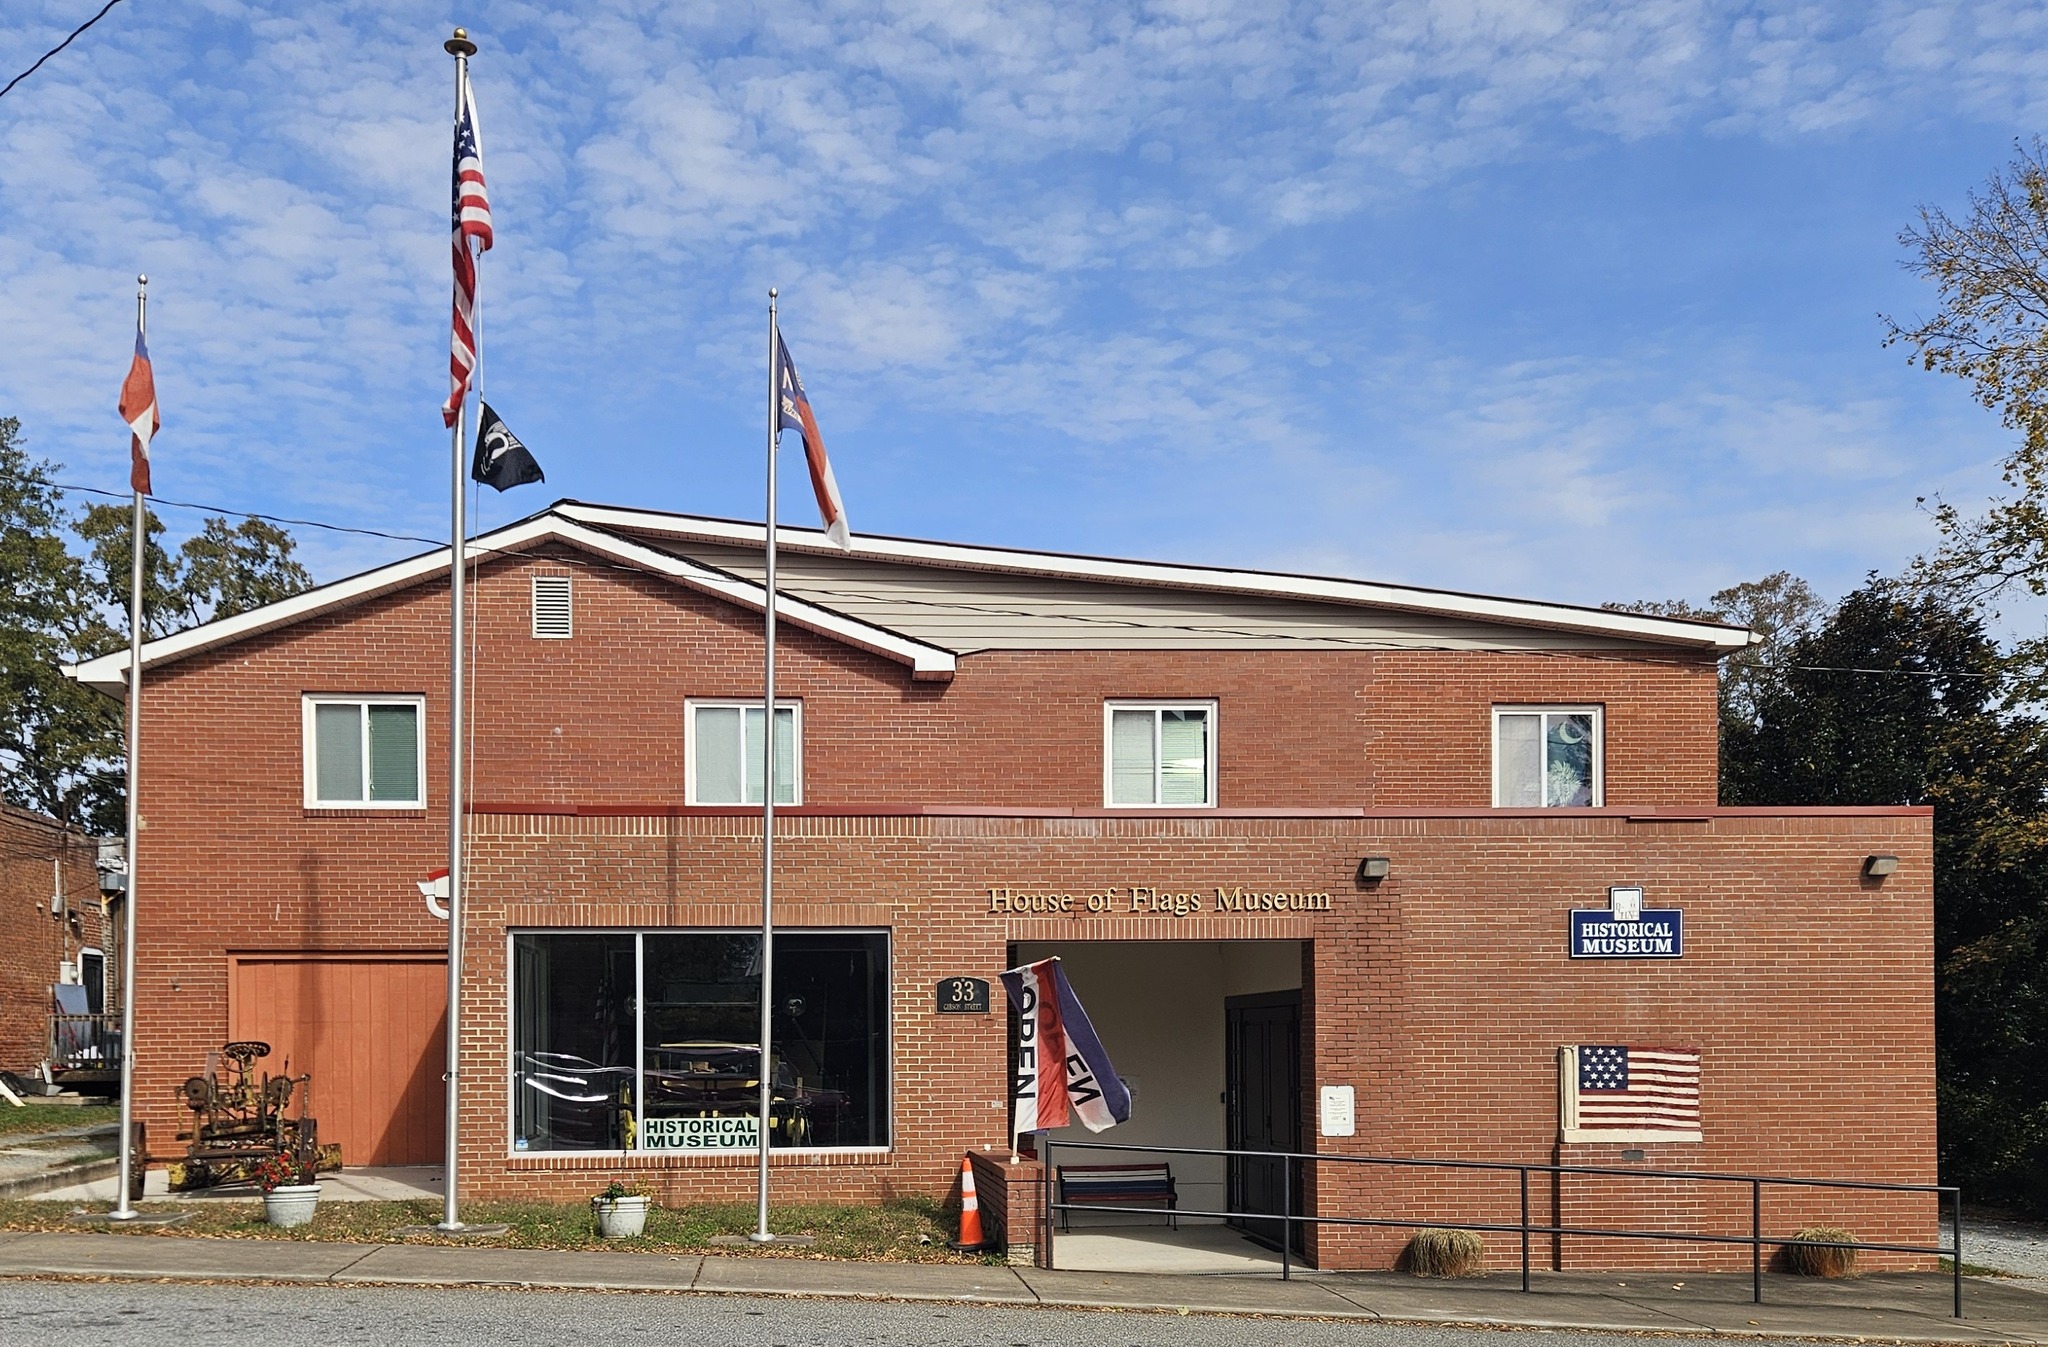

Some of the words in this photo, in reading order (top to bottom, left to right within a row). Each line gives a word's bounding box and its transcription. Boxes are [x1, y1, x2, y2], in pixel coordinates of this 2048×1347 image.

[988, 887, 1074, 913] House
[1086, 886, 1117, 913] of
[1129, 887, 1202, 917] Flags
[1214, 886, 1332, 913] Museum
[1581, 922, 1673, 938] HISTORICAL
[1582, 938, 1673, 953] MUSEUM
[952, 981, 974, 1002] 33
[964, 1003, 982, 1011] STREET
[1017, 986, 1037, 1099] OPEN
[646, 1120, 757, 1134] HISTORICAL
[646, 1134, 757, 1148] MUSEUM
